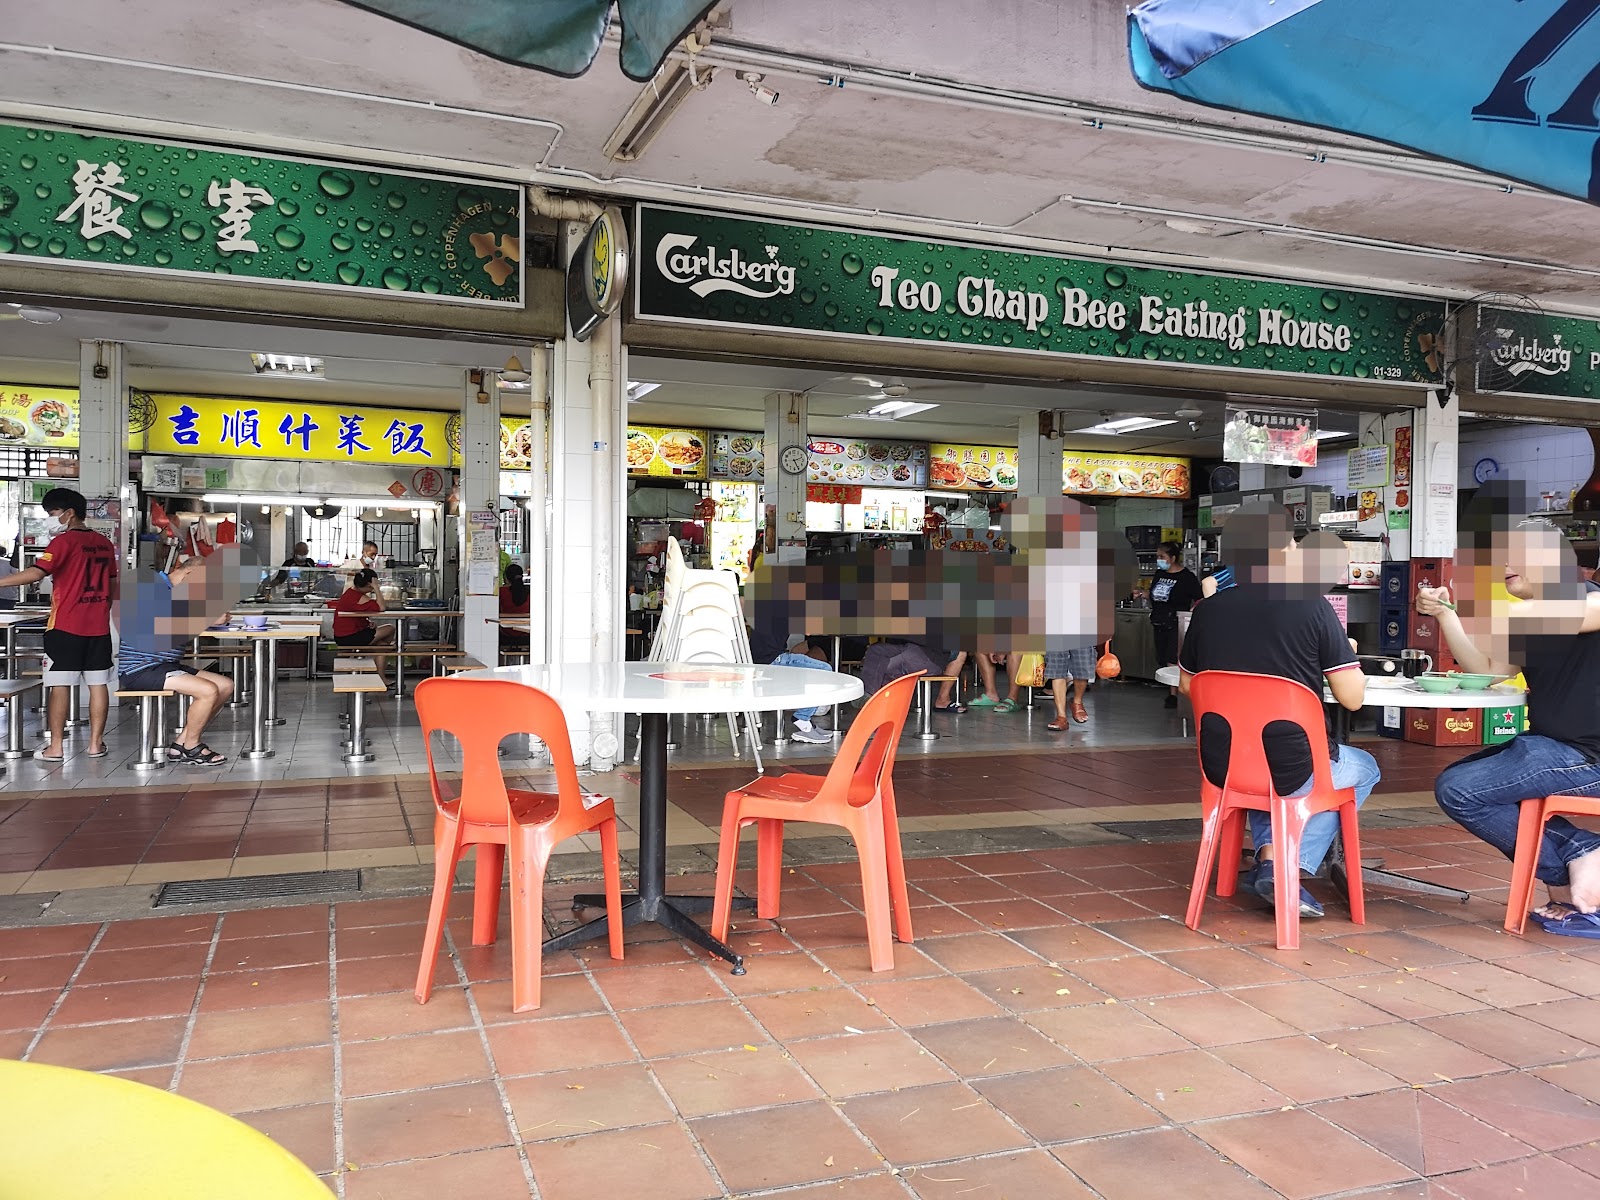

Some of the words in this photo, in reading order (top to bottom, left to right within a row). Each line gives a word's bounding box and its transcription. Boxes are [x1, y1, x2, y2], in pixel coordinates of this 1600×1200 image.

[56, 158, 276, 254] 餐室
[444, 202, 493, 269] COPENHAGEN
[656, 232, 796, 299] Carlsberg
[871, 264, 942, 313] Teo
[957, 275, 1049, 331] Chap
[1062, 287, 1126, 331] Bee
[1139, 295, 1247, 352] Eating
[1258, 308, 1351, 353] House
[1373, 366, 1402, 379] 01-329
[168, 404, 432, 458] 吉順什菜飯
[1085, 458, 1131, 468] EASTERN
[1133, 460, 1179, 470] SEAFOOD
[83, 556, 110, 592] 17
[1445, 717, 1474, 733] Carlsberg
